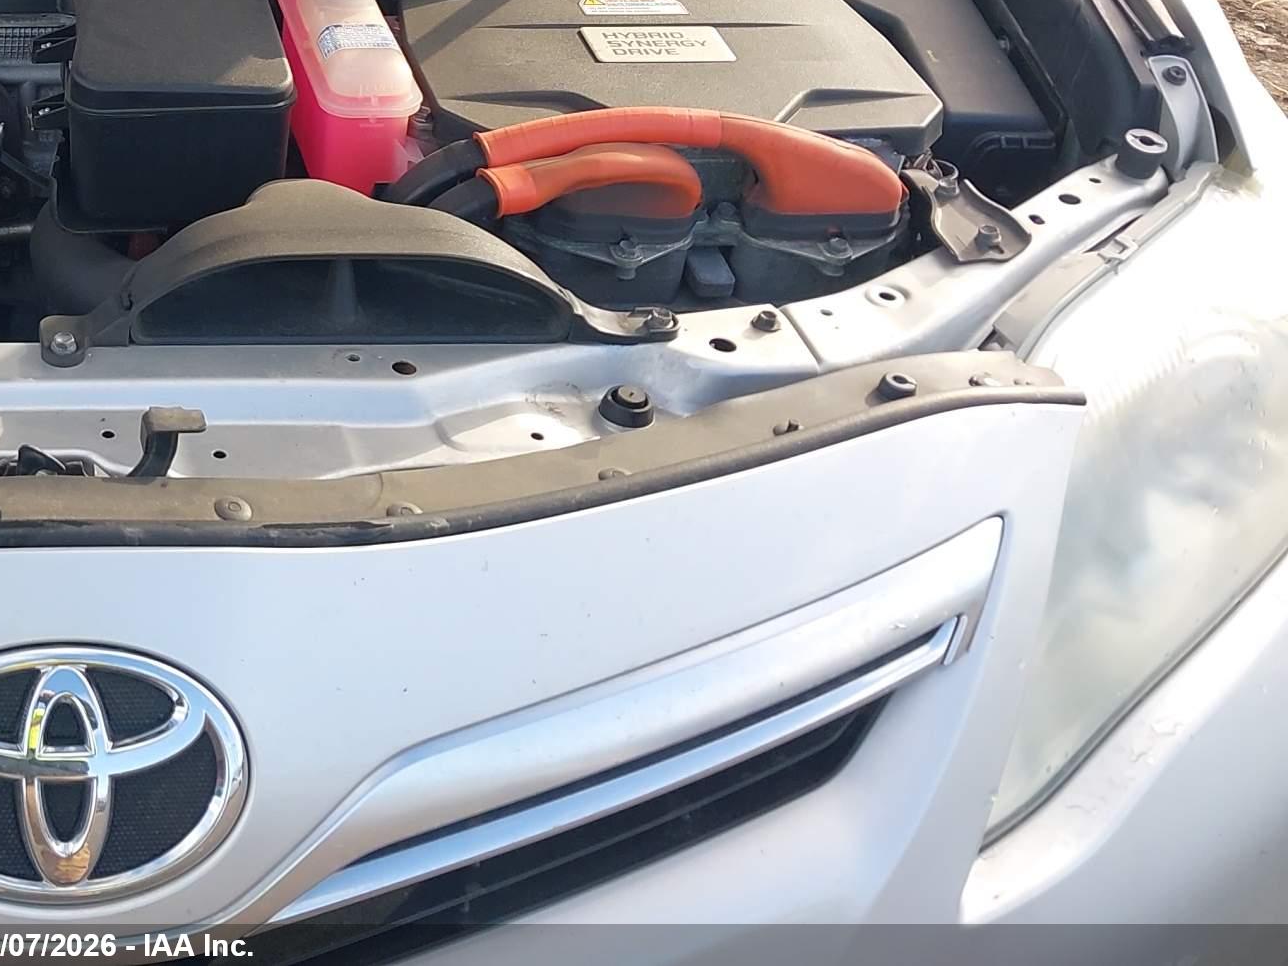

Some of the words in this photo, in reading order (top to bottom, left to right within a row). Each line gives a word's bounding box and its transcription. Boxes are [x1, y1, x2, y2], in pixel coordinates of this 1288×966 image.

[602, 31, 684, 40] HYBRID
[606, 39, 707, 48] SYNERGY
[612, 48, 680, 56] DRIVE
